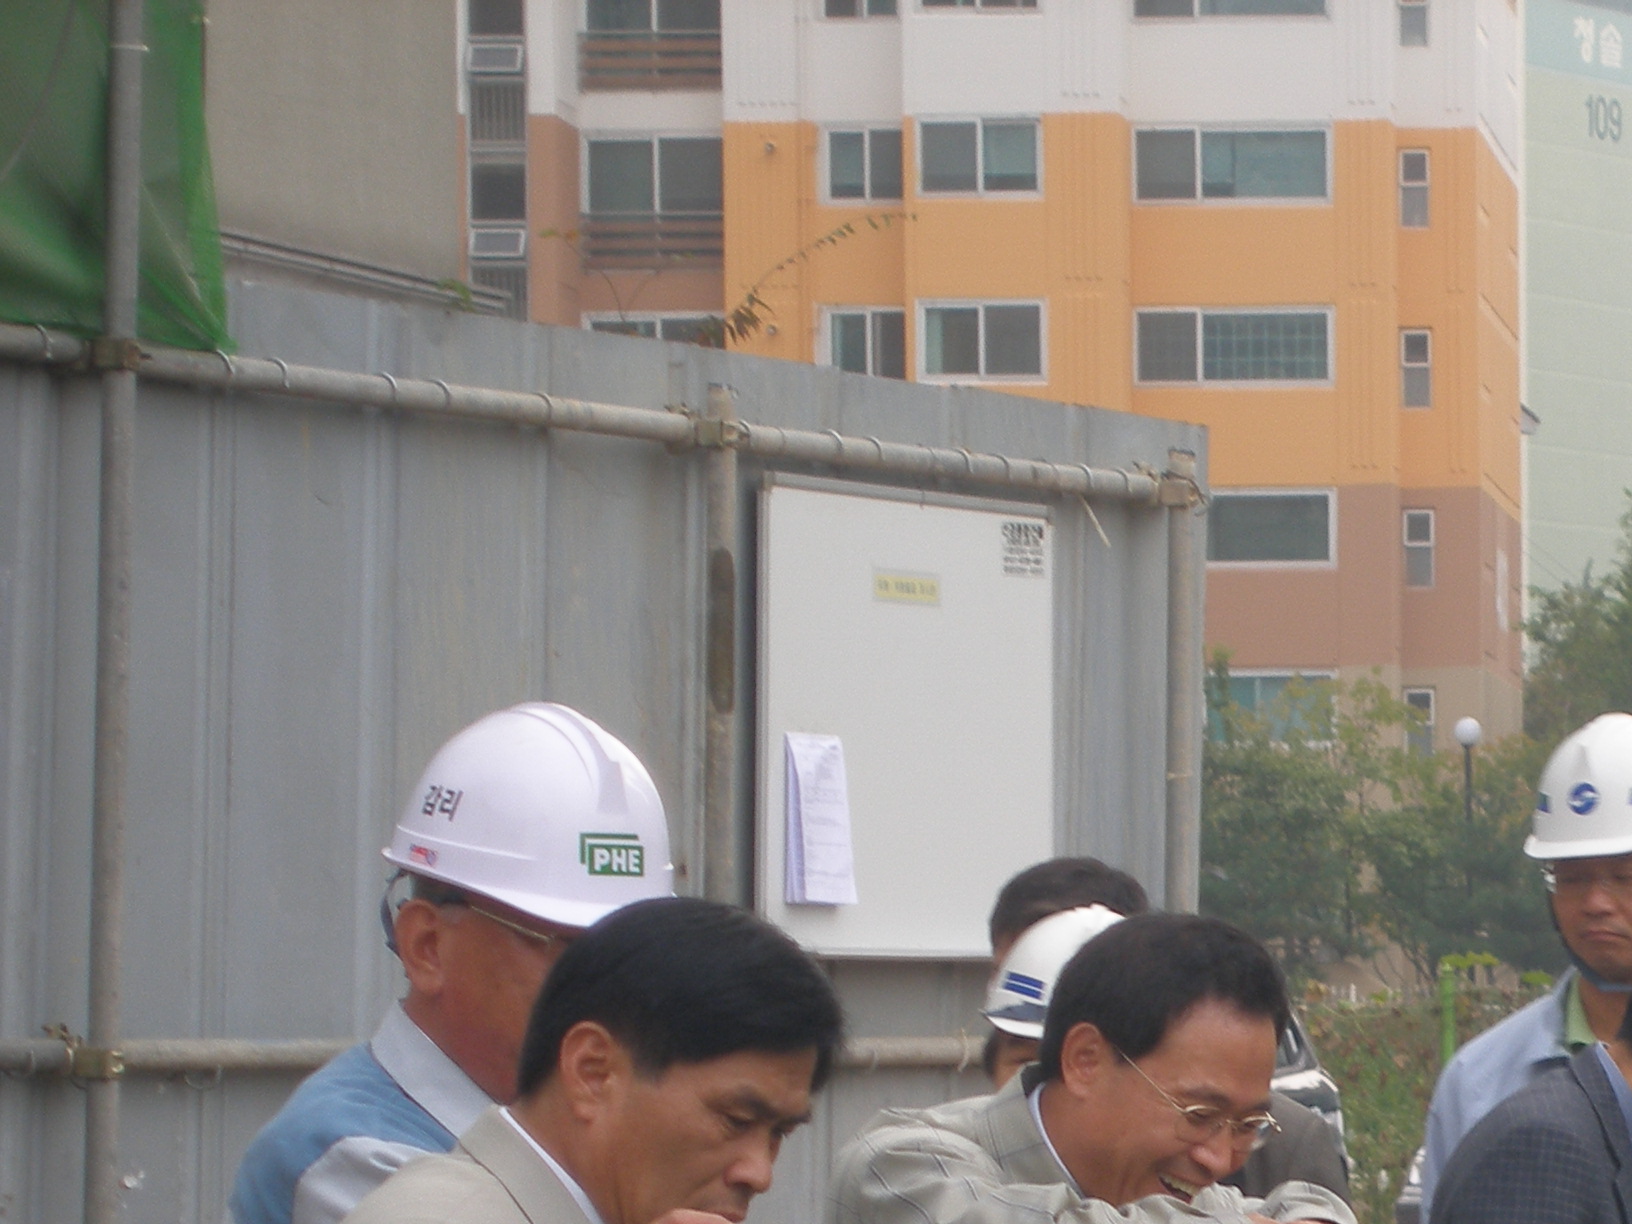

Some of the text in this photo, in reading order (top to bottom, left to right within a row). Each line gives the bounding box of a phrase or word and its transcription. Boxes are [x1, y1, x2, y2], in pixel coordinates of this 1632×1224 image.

[1585, 94, 1622, 142] 109
[422, 785, 463, 821] 감리
[593, 847, 641, 873] PHE
